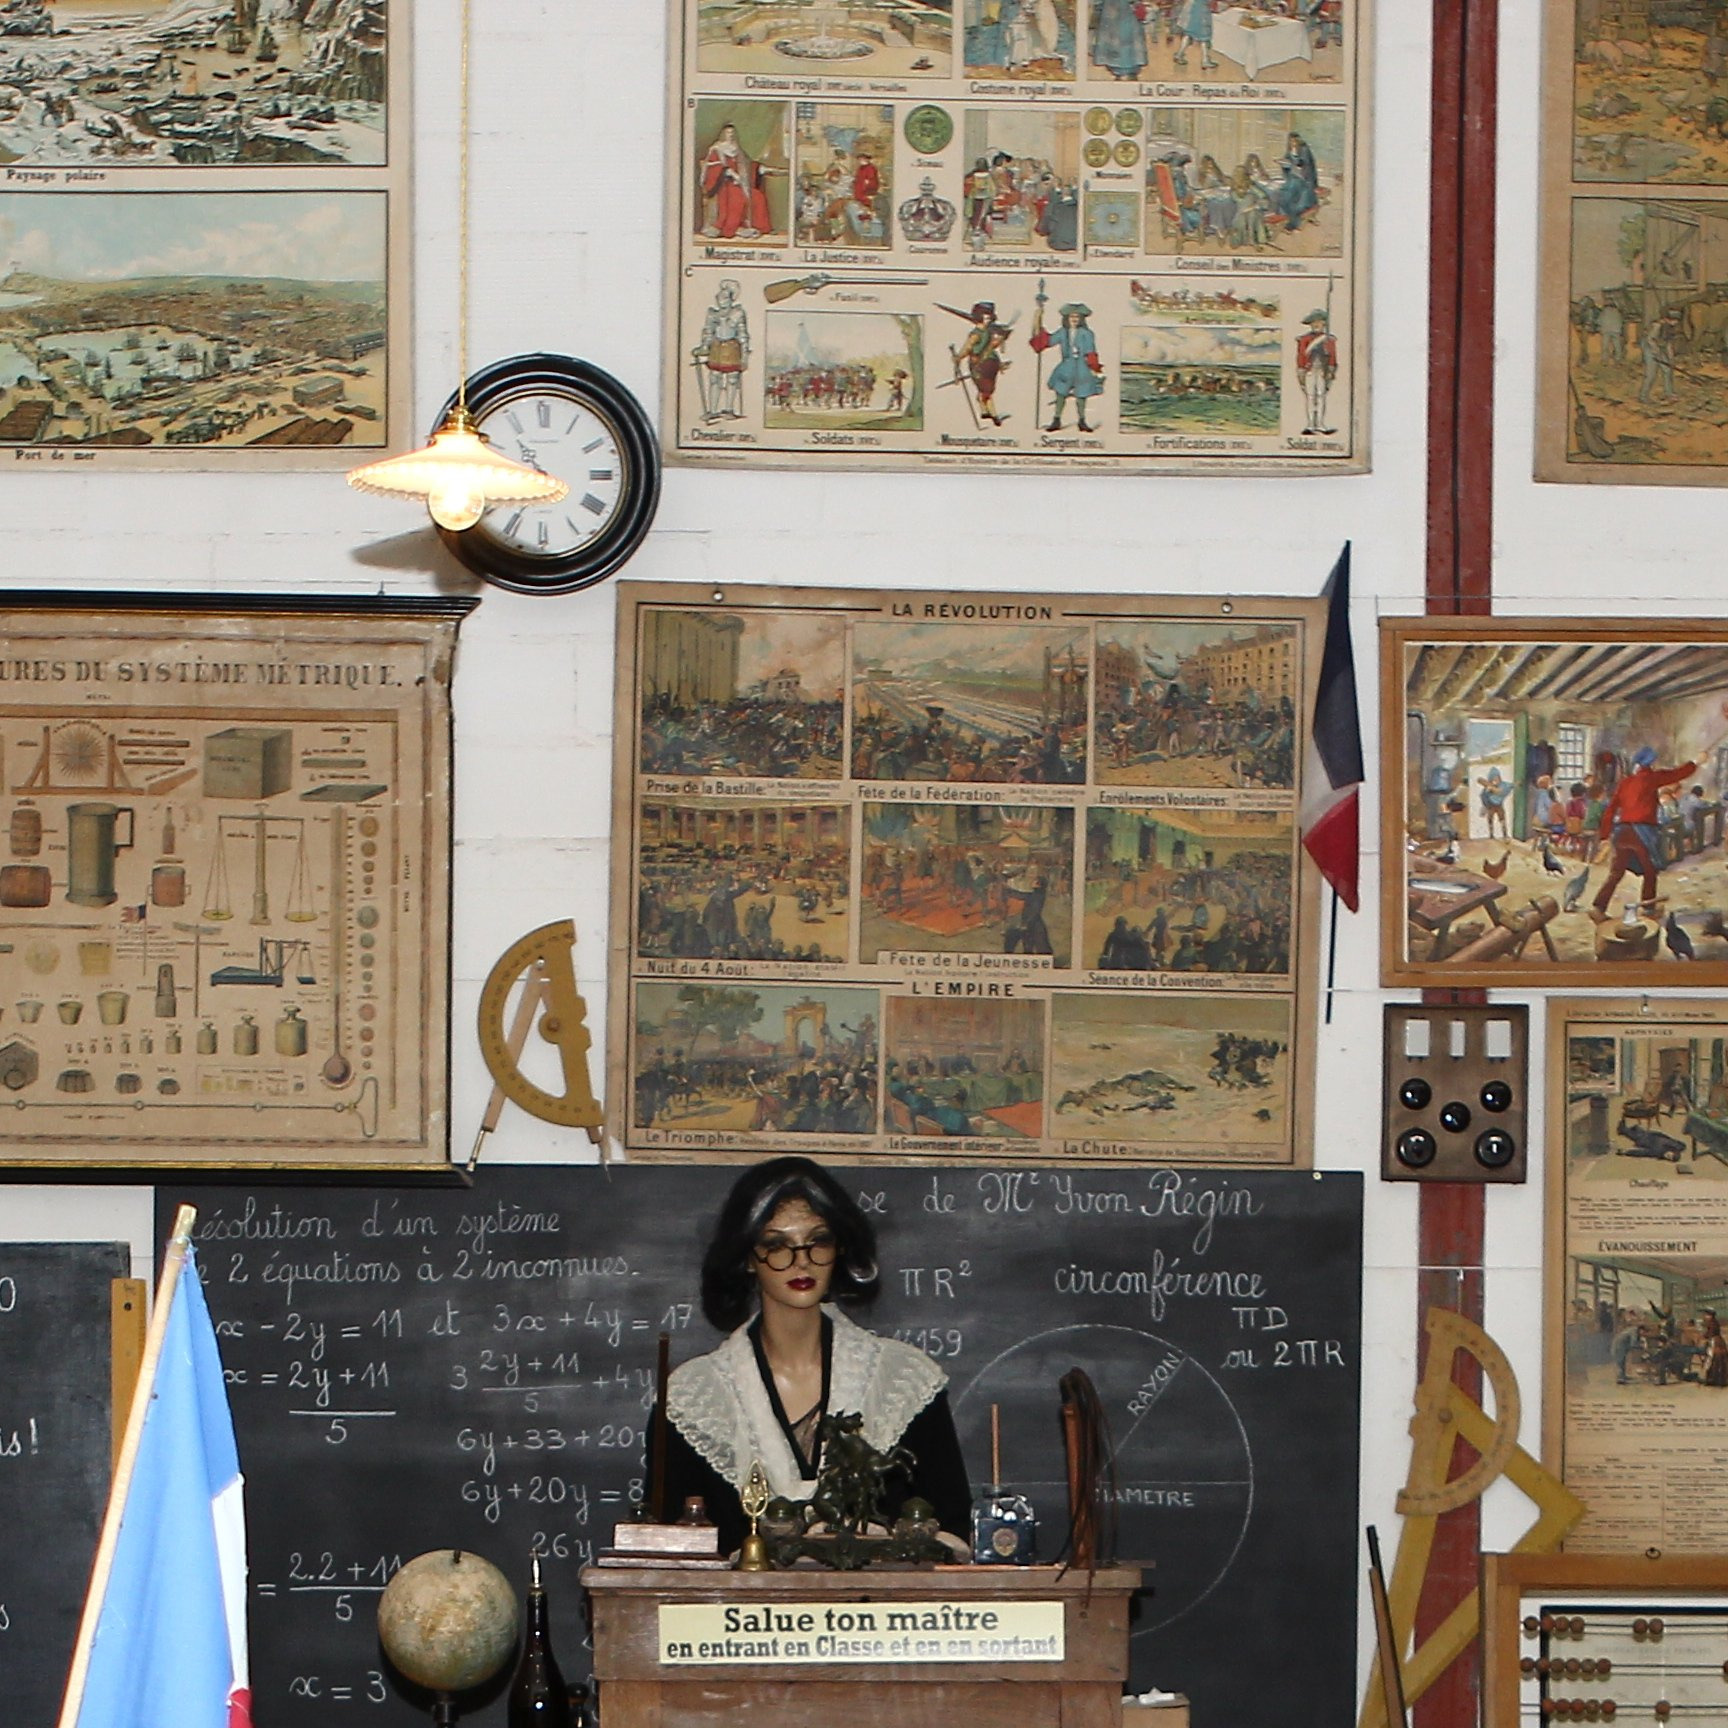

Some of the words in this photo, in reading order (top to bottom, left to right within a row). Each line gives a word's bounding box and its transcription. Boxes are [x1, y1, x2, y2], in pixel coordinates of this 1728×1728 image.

[892, 603, 914, 617] LA
[75, 661, 109, 682] DU
[647, 779, 680, 794] Prise
[683, 780, 700, 794] de
[703, 780, 714, 794] la
[891, 787, 906, 800] de
[909, 787, 921, 800] la
[932, 953, 949, 967] de
[953, 953, 969, 967] la
[974, 953, 1051, 969] Jeunesse
[912, 981, 1016, 997] L'EMPIRE
[923, 1175, 956, 1214] de
[456, 1208, 561, 1254] système
[228, 1254, 250, 1281] 2
[261, 1254, 402, 1304] équations
[417, 1246, 445, 1283] à
[452, 1250, 475, 1278] 2
[1054, 1249, 1267, 1320] circonférence
[372, 1309, 403, 1338] 11
[429, 1306, 461, 1337] et
[1126, 1350, 1184, 1418] RAYON
[327, 1418, 348, 1445] 5
[523, 1429, 566, 1450] 33
[723, 1606, 814, 1634] Salue
[824, 1608, 876, 1633] ton
[886, 1603, 999, 1633] maître
[666, 1640, 694, 1659] en
[698, 1638, 780, 1660] entrant
[783, 1639, 811, 1658] en
[815, 1635, 887, 1658] Classe
[890, 1637, 912, 1658] et
[915, 1639, 943, 1658] en
[945, 1639, 973, 1658] en
[976, 1634, 1058, 1658] sortant
[366, 1671, 387, 1703] 3
